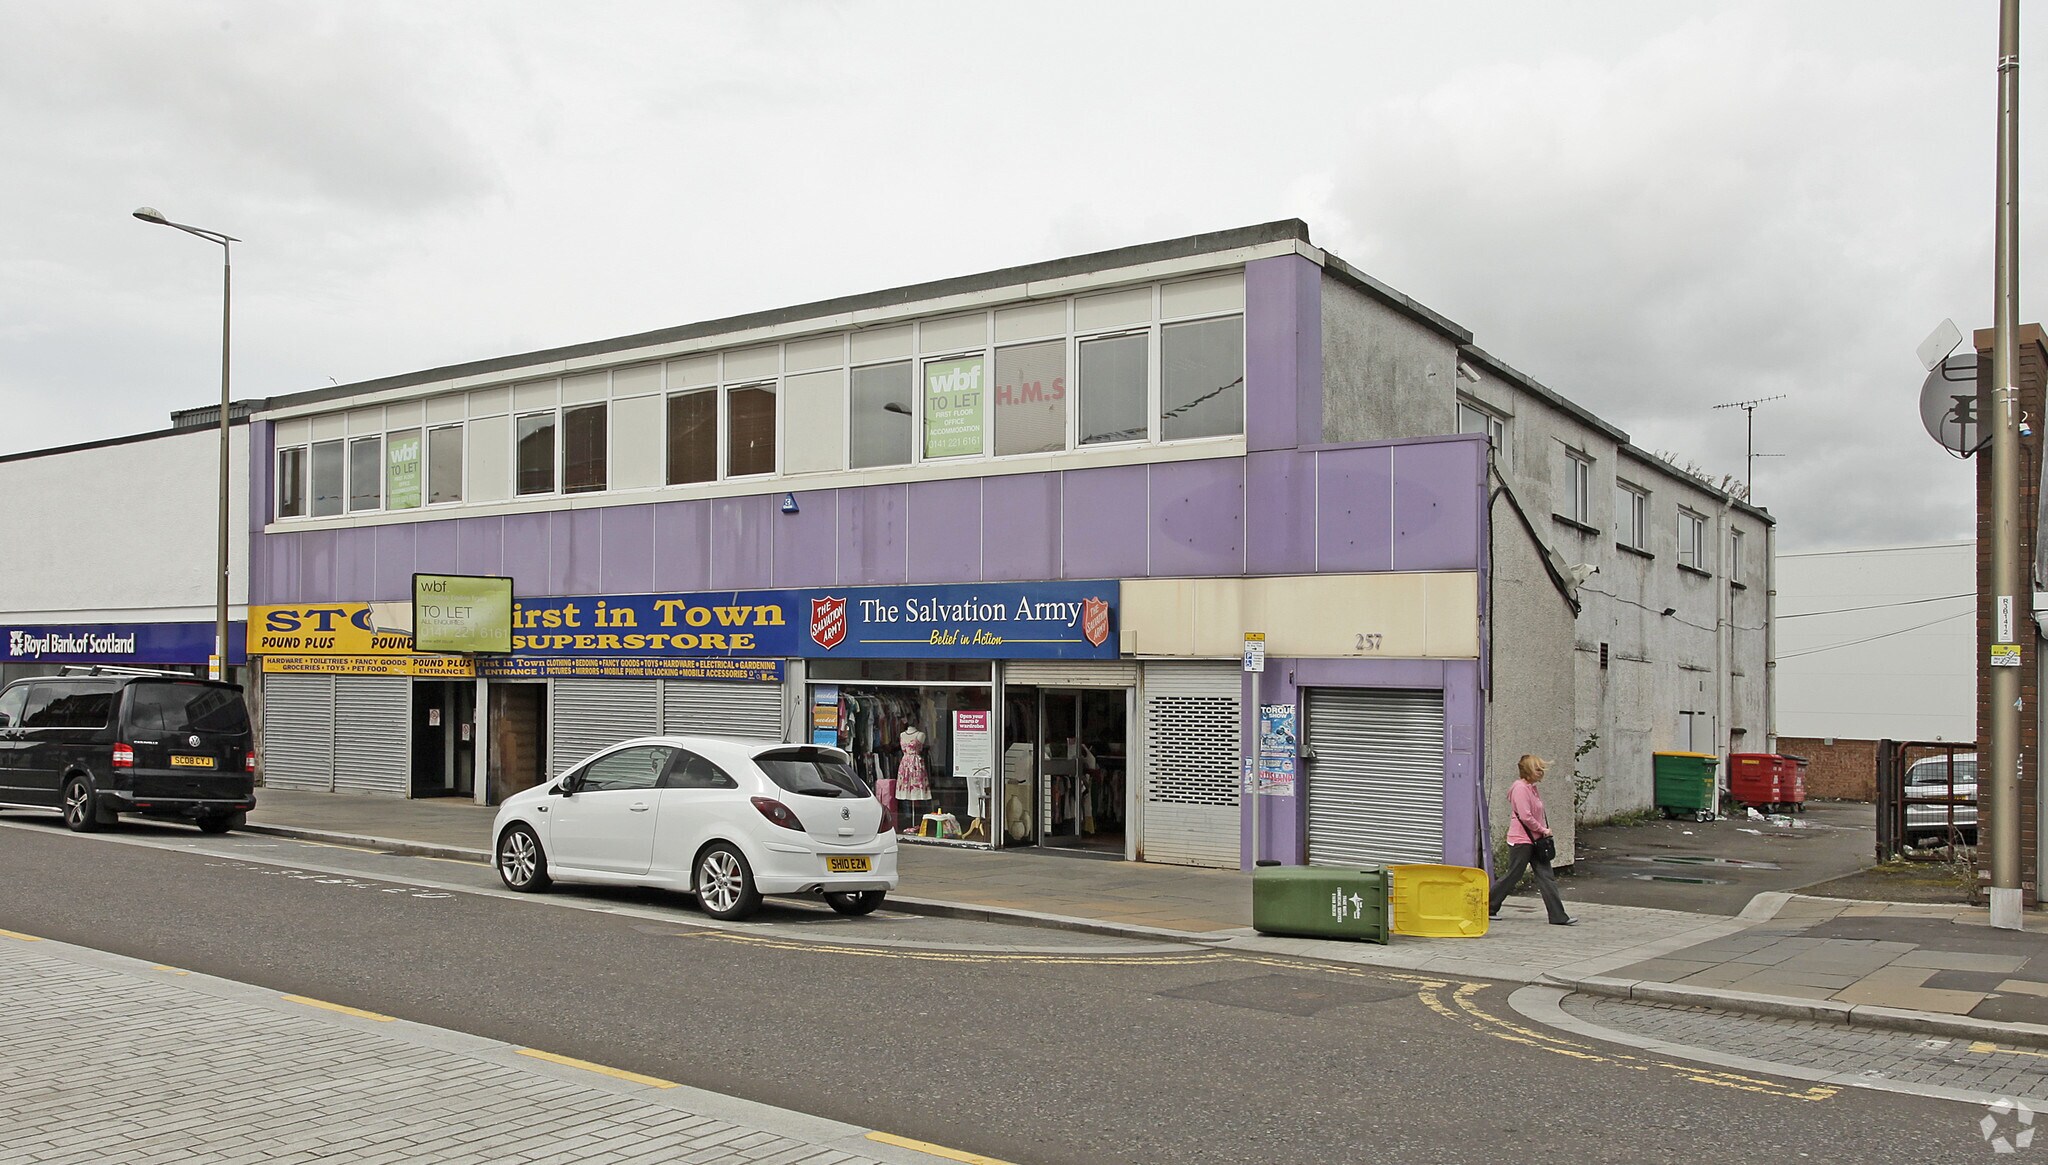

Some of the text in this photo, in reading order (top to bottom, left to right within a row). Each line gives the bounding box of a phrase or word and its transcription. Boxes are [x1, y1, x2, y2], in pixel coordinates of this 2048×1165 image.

[930, 365, 981, 394] wbf
[996, 377, 1065, 406] H.M.S
[930, 392, 980, 411] TO LET
[935, 408, 974, 419] FIRST FLOOR
[944, 417, 965, 426] OFFICE
[930, 425, 980, 436] ACCOMMODATION
[929, 436, 980, 449] 0141 221 6161
[390, 442, 418, 464] wbf
[391, 461, 418, 476] TO LET
[420, 580, 447, 593] wbf
[420, 604, 472, 619] TO LET
[513, 599, 786, 628] irst in Town
[817, 600, 832, 618] THE
[859, 596, 1083, 627] The Salvation Army
[812, 603, 843, 636] SALVATION
[480, 628, 508, 639] 6161
[823, 618, 842, 642] ARMY
[261, 637, 335, 649] POUND PLUS
[371, 637, 412, 649] POUND
[512, 633, 755, 650] SUPERSTORE
[930, 629, 1004, 646] Belief in Action
[1355, 633, 1382, 650] 257
[24, 632, 135, 659] Royal Bank of Scotland
[412, 659, 472, 667] POUND PLUS
[476, 659, 546, 667] First in Town
[602, 659, 619, 667] FANCY
[620, 659, 640, 667] GOODS
[663, 660, 695, 668] HARDWARE
[699, 660, 735, 669] ELECTRICAL
[739, 661, 776, 670] GARDENING
[485, 668, 538, 676] ENTRANCE
[625, 668, 644, 676] PHONE
[682, 669, 705, 677] MOBILE
[706, 669, 748, 678] ACCESSORIES
[1260, 706, 1295, 714] TORQUE
[174, 757, 211, 766] SC08 CYJ
[831, 858, 850, 870] SH10
